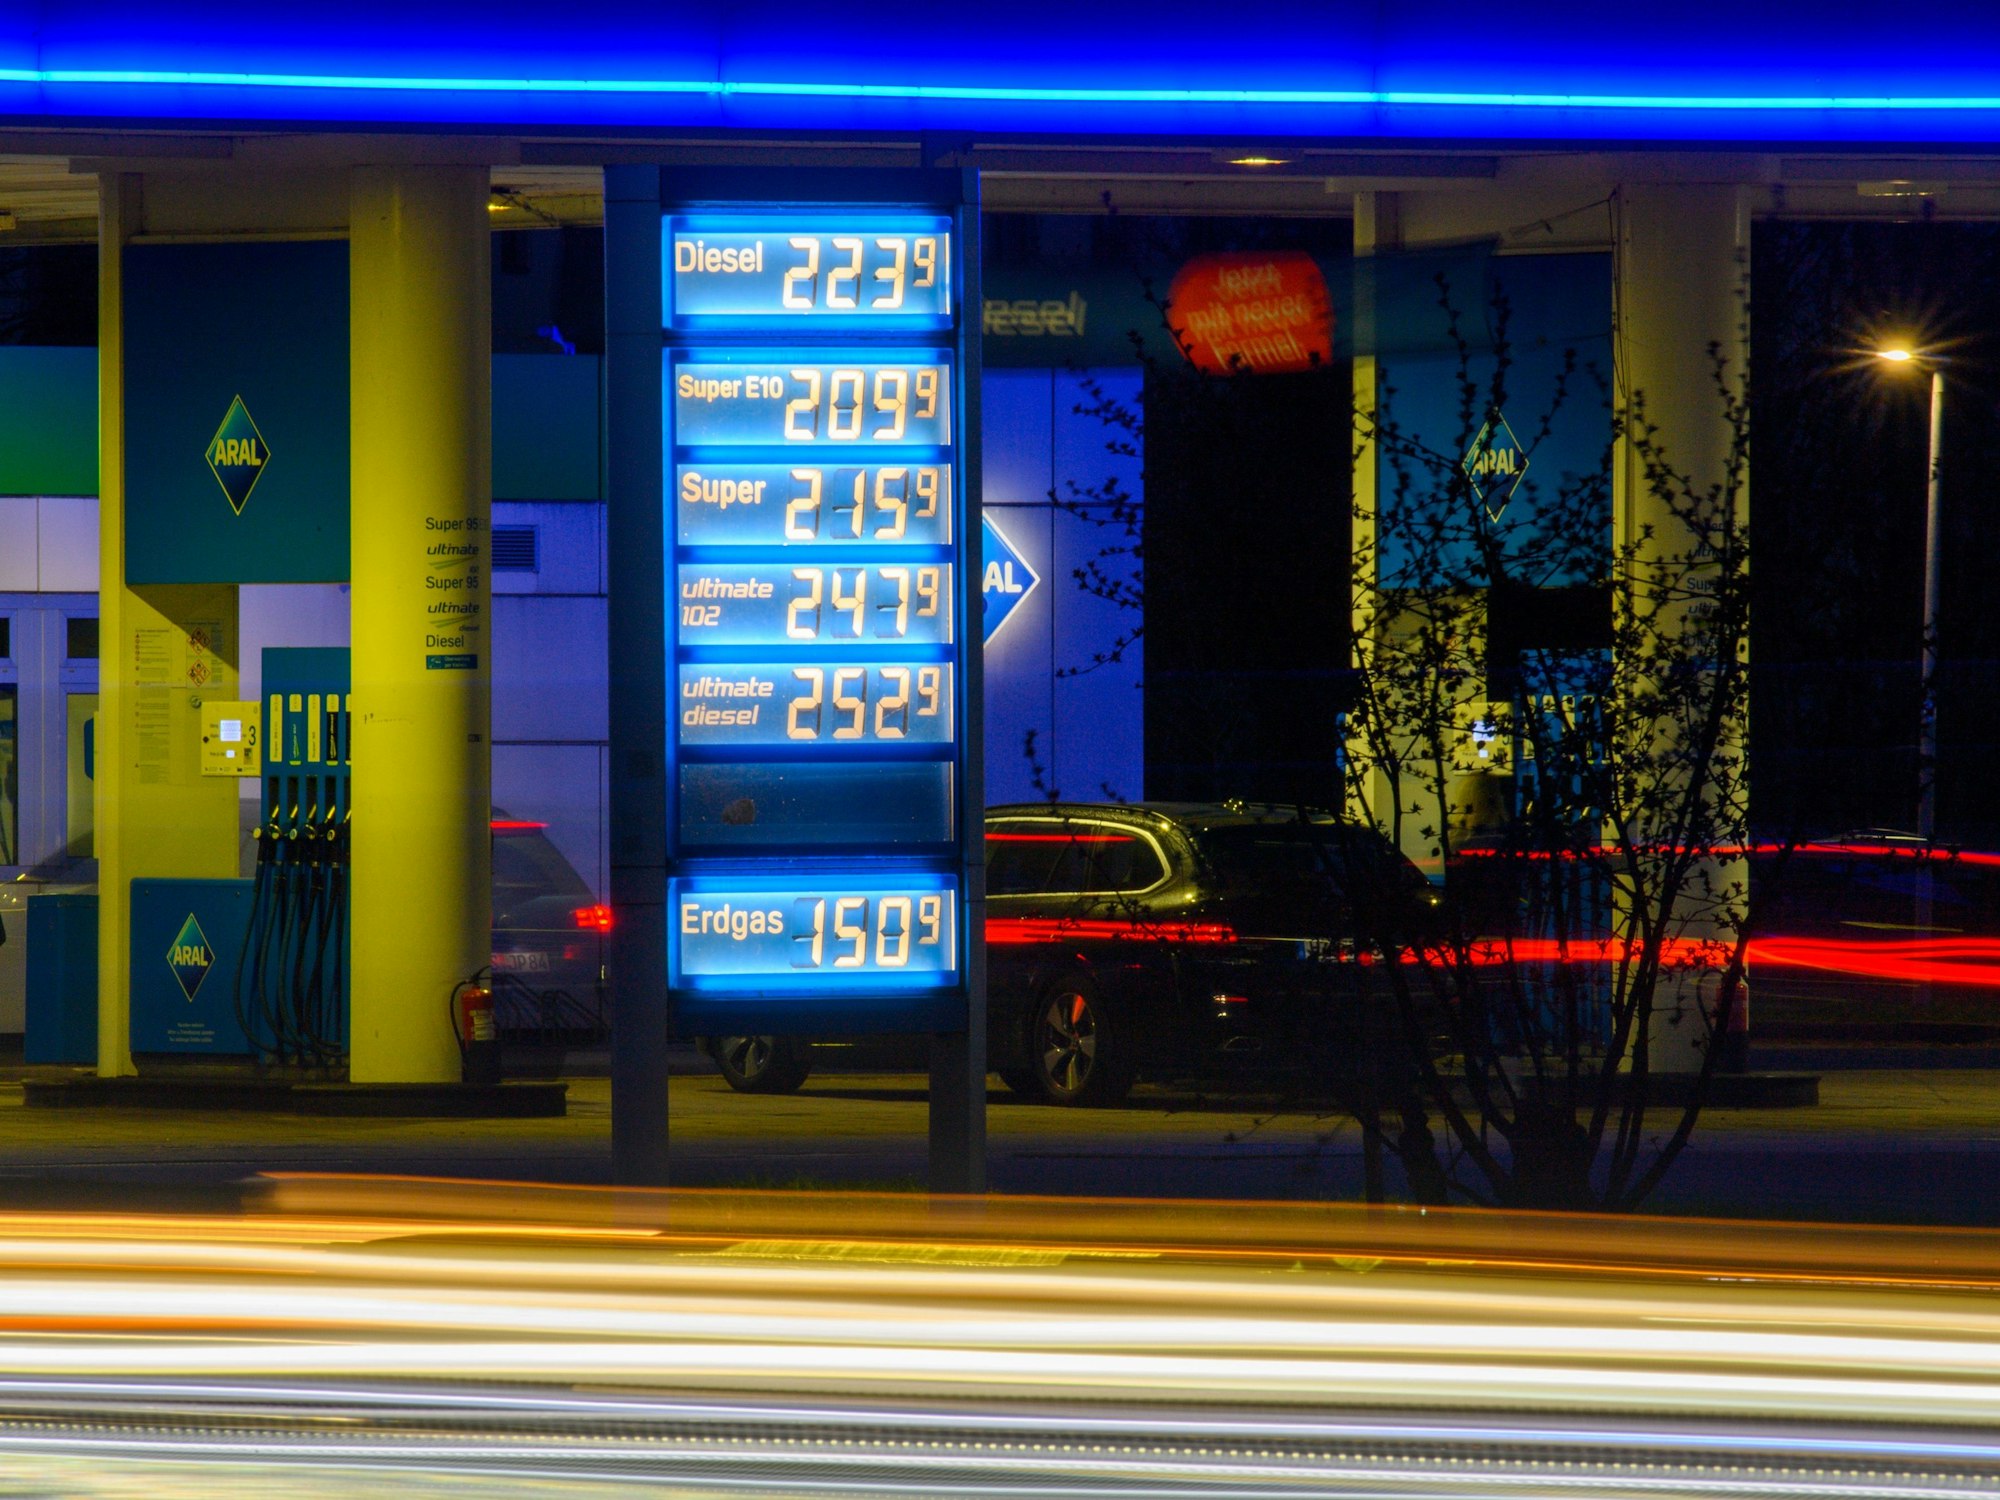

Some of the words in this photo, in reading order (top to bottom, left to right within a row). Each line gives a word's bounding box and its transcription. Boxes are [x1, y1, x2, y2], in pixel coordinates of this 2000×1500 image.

[675, 240, 763, 273] Diesel
[679, 374, 742, 402] Super
[745, 375, 784, 399] E10
[214, 438, 262, 466] ARAL
[1471, 448, 1520, 475] ARAL
[682, 472, 766, 509] Super
[425, 517, 463, 532] Super
[466, 518, 478, 531] 95
[427, 543, 479, 555] ultimate
[425, 576, 463, 591] Super
[466, 576, 479, 589] 95
[682, 578, 774, 598] ultimate
[983, 562, 1022, 593] AL
[428, 602, 480, 613] ultimate
[682, 606, 721, 626] 102
[426, 635, 464, 648] Diesel
[682, 676, 774, 698] ultimate
[683, 704, 759, 726] diesel
[248, 725, 257, 746] 3
[681, 903, 784, 941] Erdgas
[173, 945, 209, 967] ARAL
